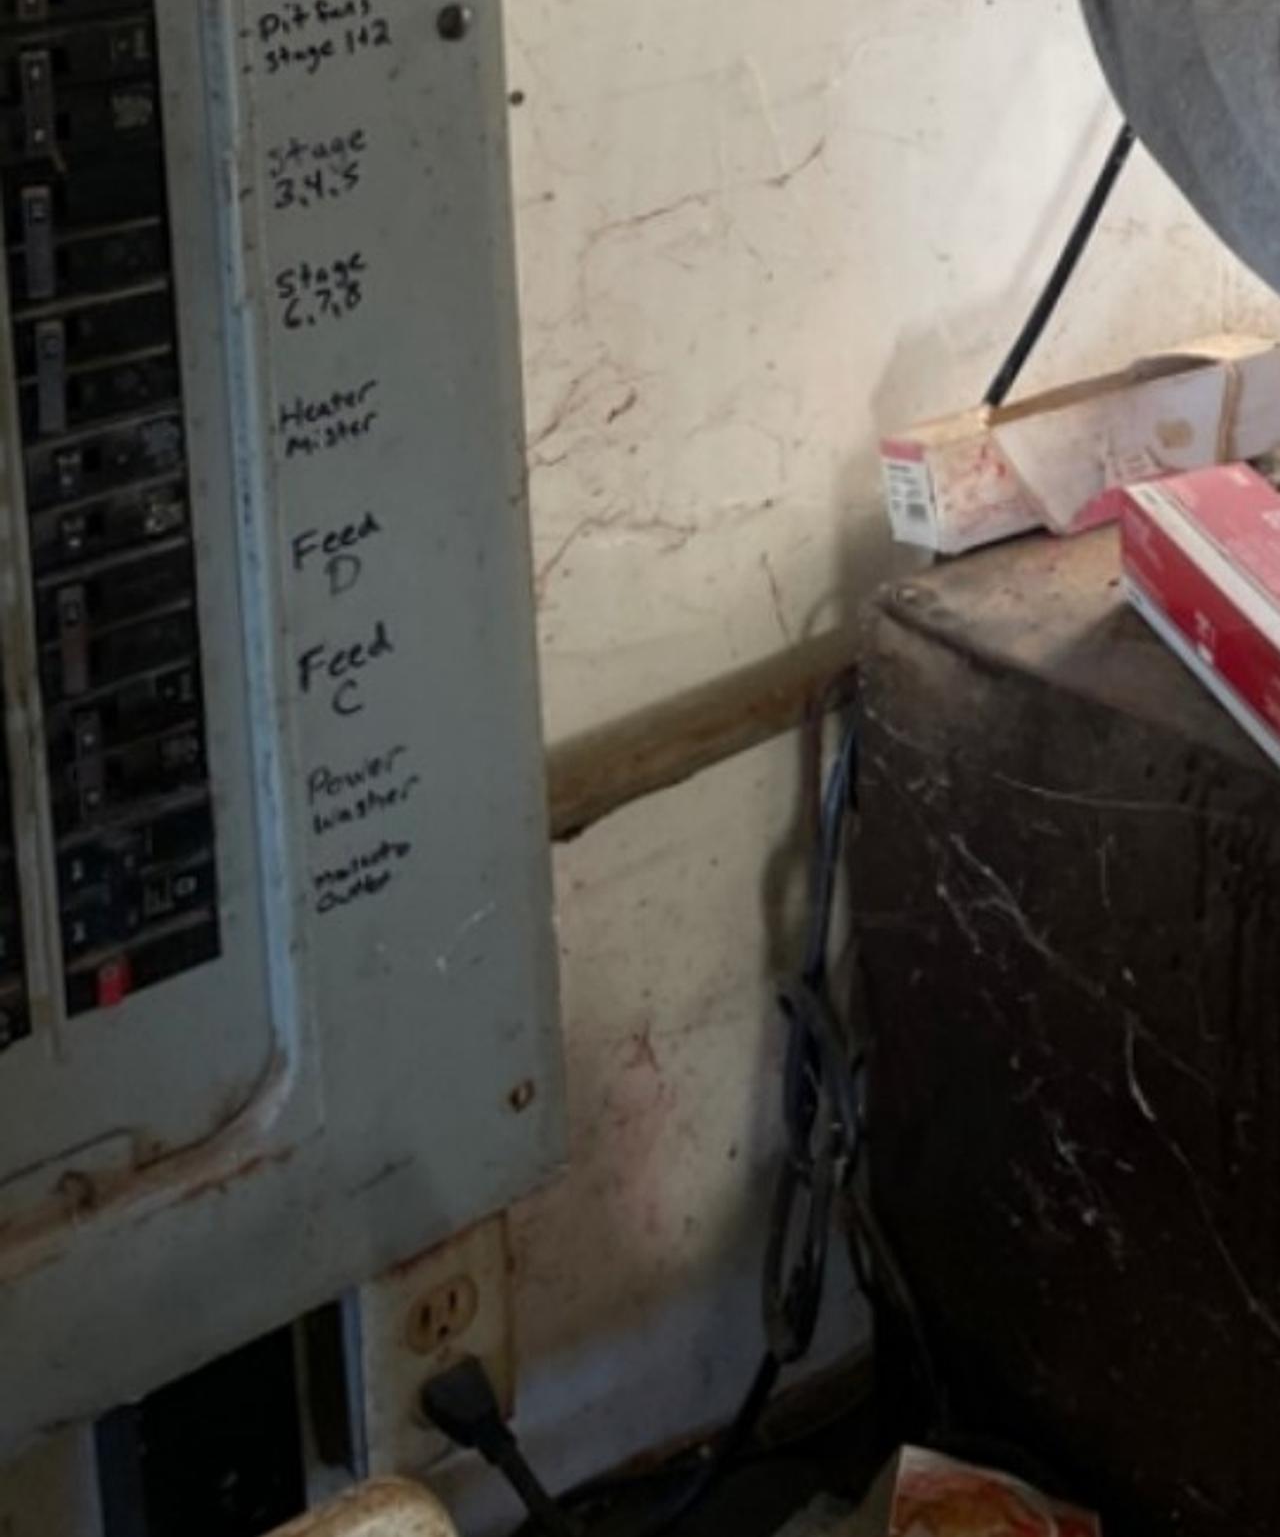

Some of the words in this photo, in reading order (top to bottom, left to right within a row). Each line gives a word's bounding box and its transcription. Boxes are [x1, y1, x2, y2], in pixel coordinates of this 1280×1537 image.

[291, 510, 382, 572] Feed
[323, 554, 363, 597] D
[297, 619, 395, 694] Feed
[331, 678, 364, 716] C
